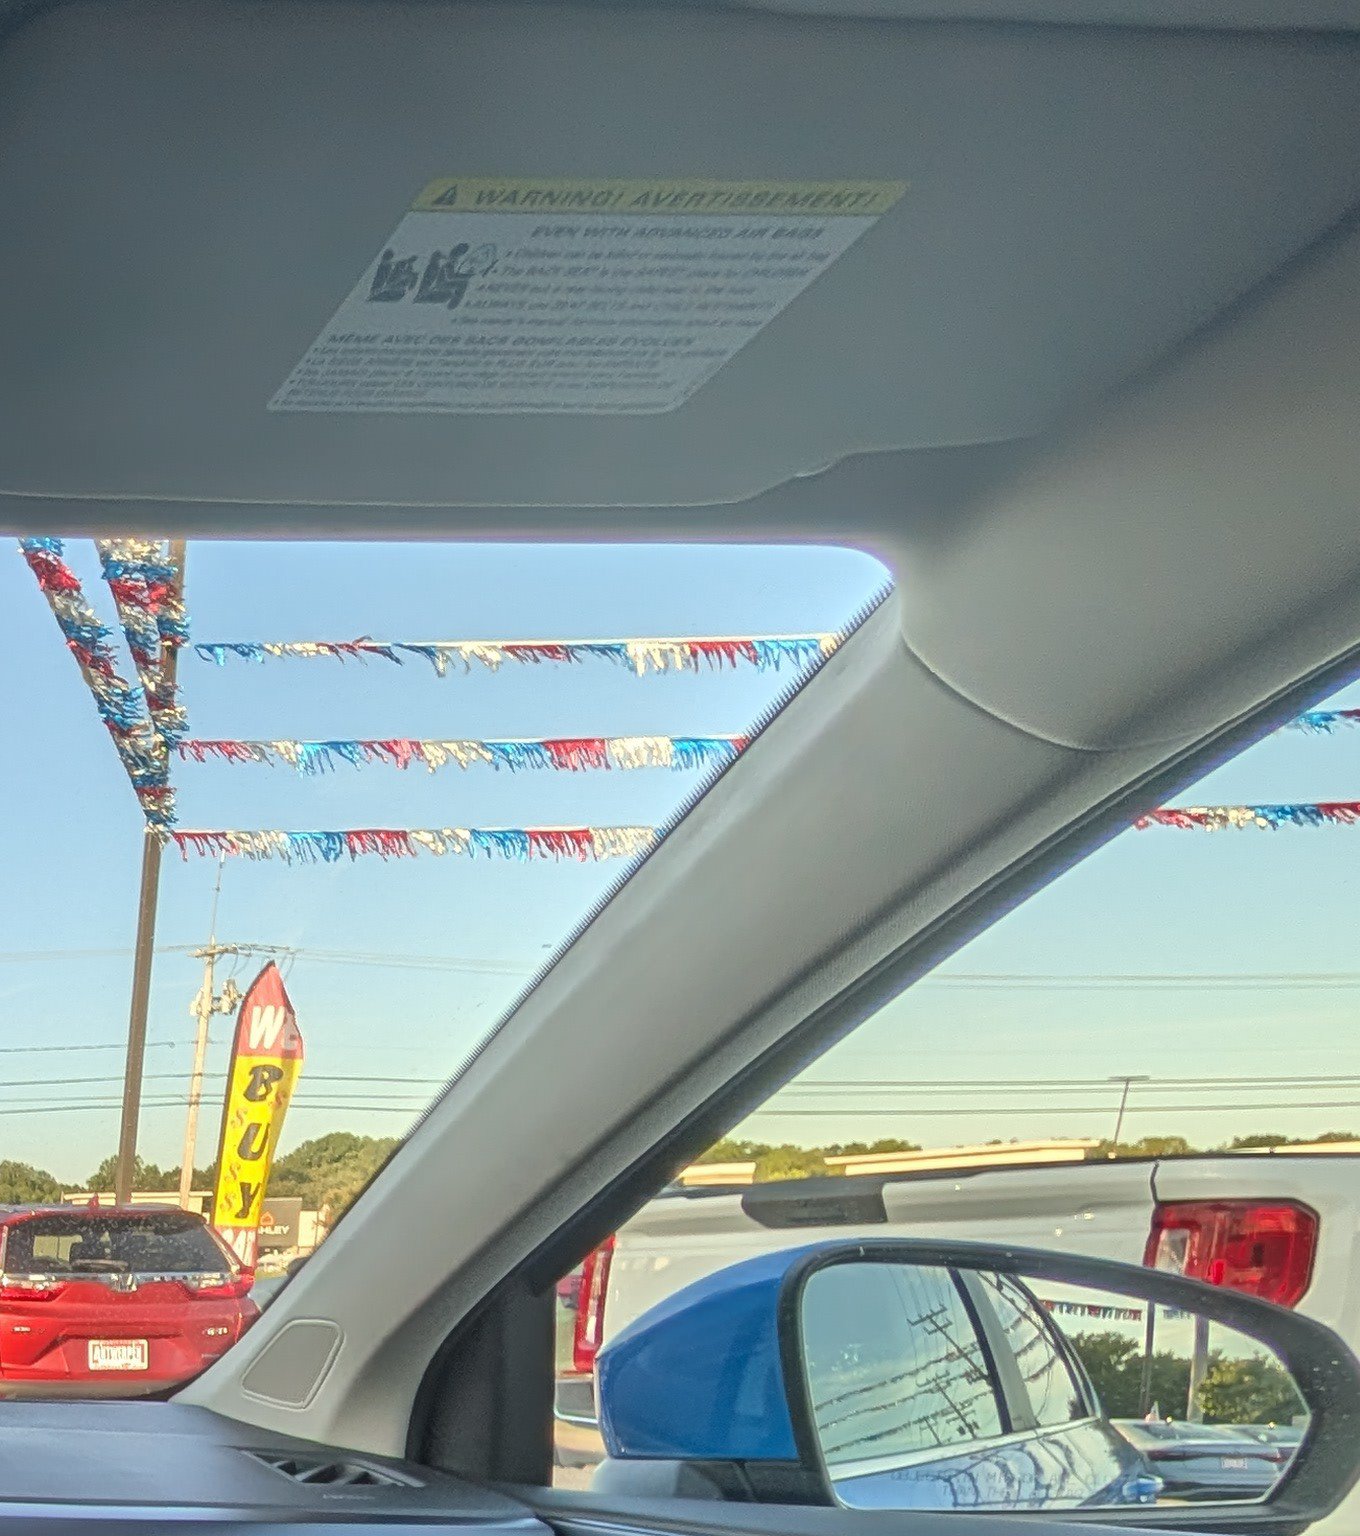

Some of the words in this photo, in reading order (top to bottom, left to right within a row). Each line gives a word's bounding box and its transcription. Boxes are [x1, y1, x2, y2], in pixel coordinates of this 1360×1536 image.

[475, 188, 624, 207] WARNING!
[631, 189, 879, 209] AVERTISSEMENT!
[236, 1064, 284, 1219] BUY
